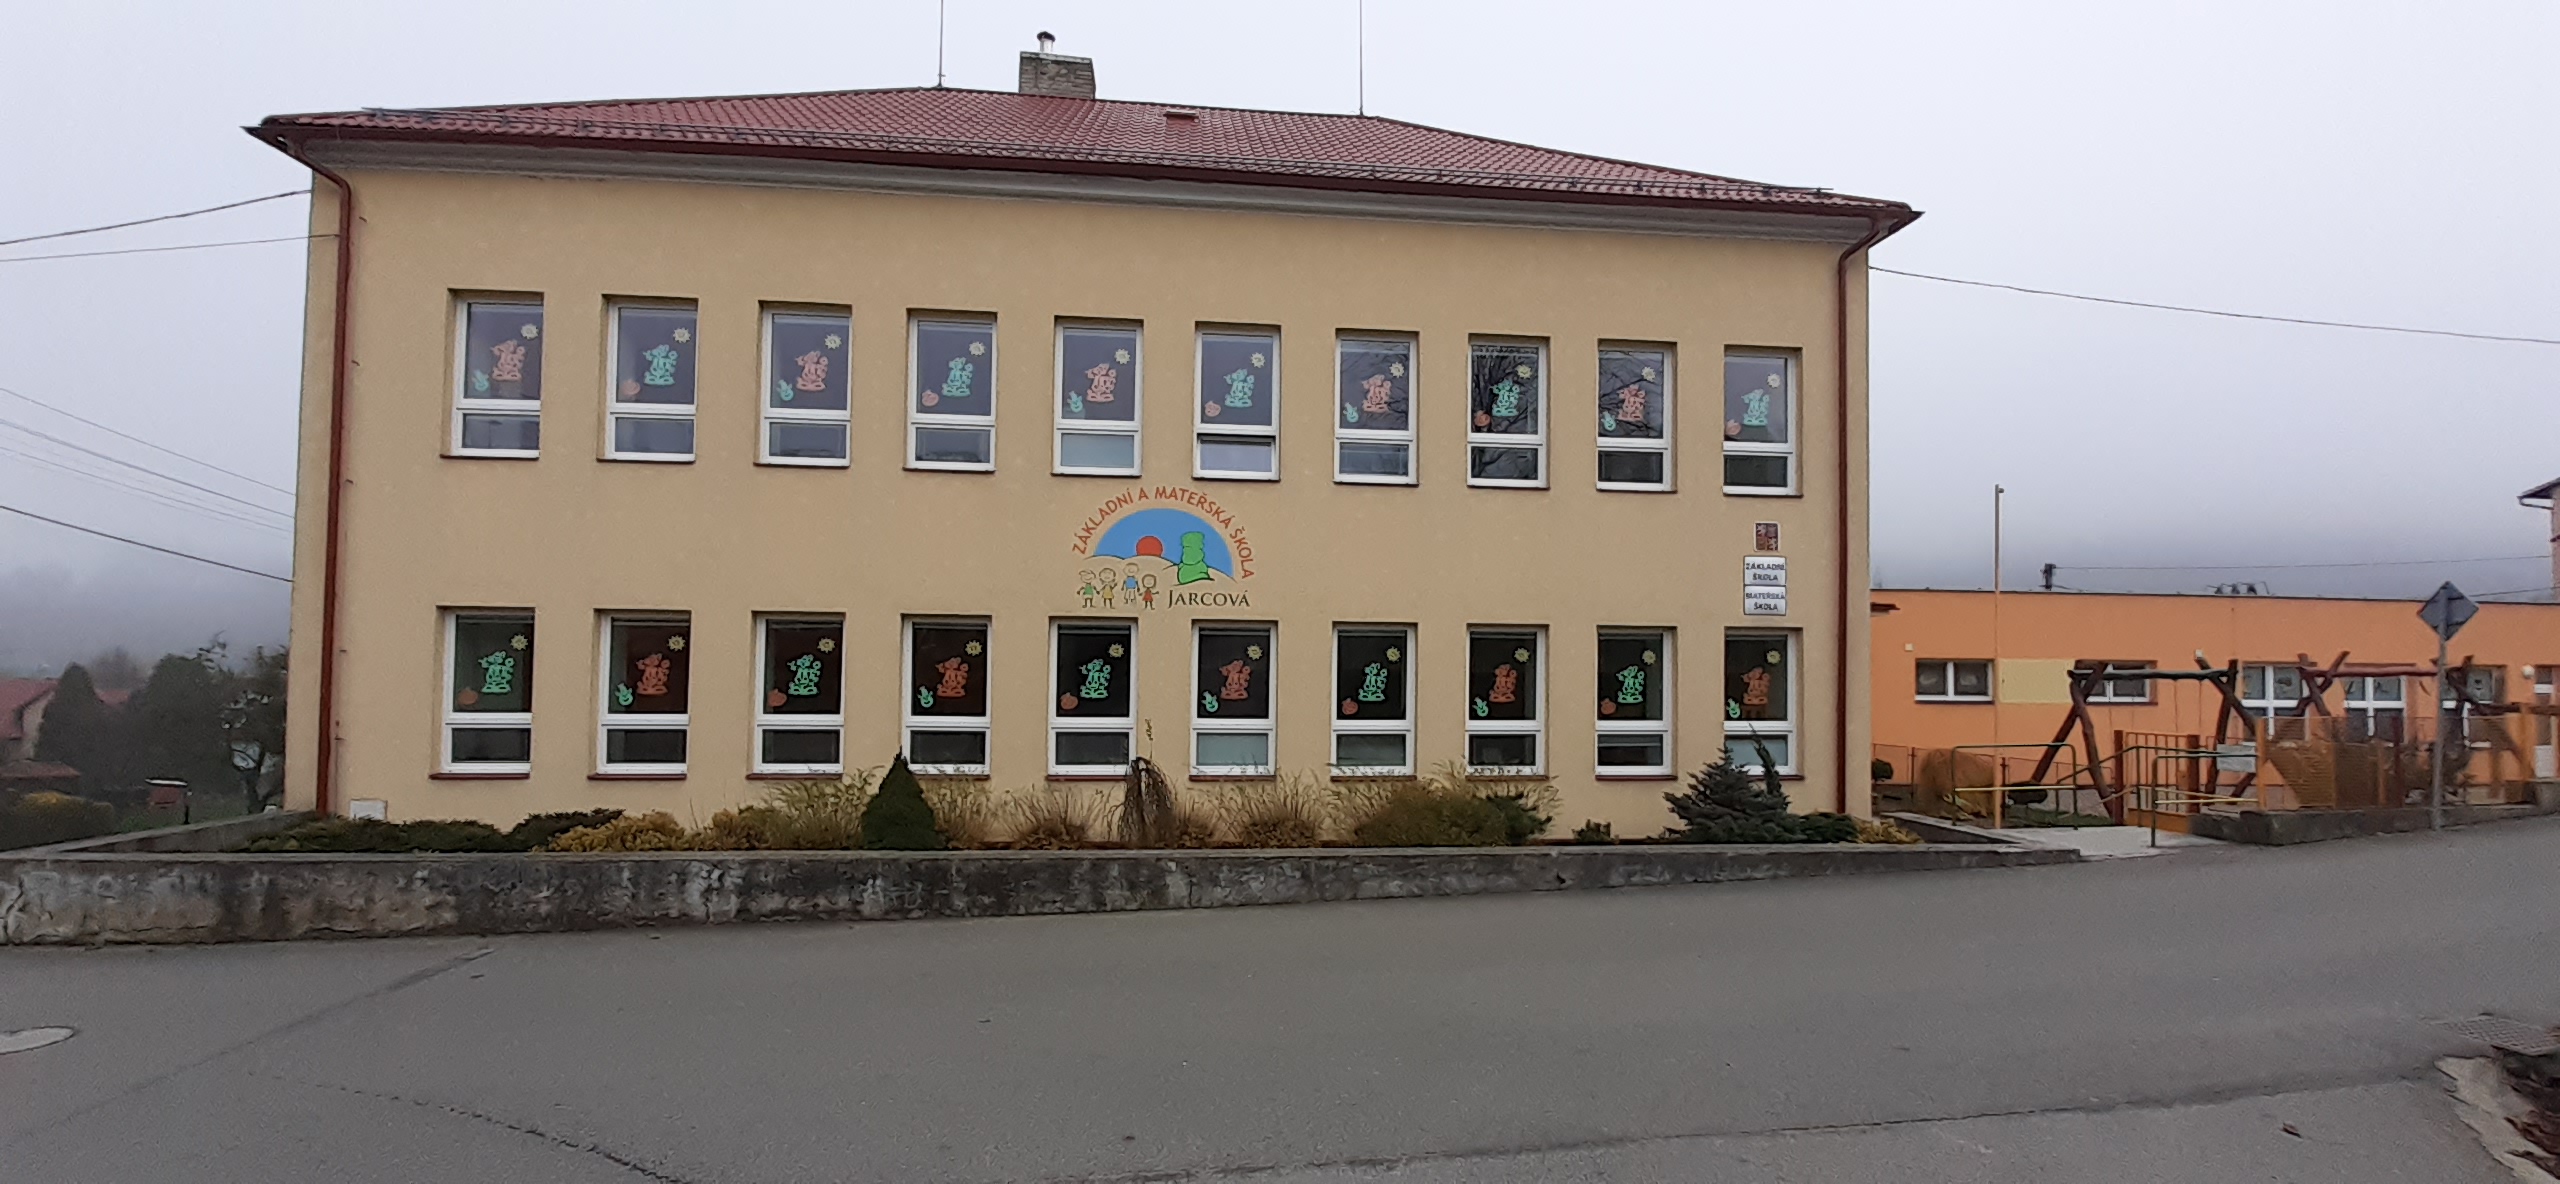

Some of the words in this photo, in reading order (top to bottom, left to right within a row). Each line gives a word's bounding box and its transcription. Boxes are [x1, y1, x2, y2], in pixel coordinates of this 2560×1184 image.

[1072, 488, 1134, 554] ZÁKLADNÍ
[1138, 487, 1149, 500] A
[1154, 486, 1235, 529] MATEŘSKÁ
[1230, 526, 1255, 579] ŠKOLA
[1745, 562, 1785, 570] ZÁKLADNÍ
[1752, 572, 1778, 581] ŠKOLA
[1753, 602, 1778, 611] ŠKOLA
